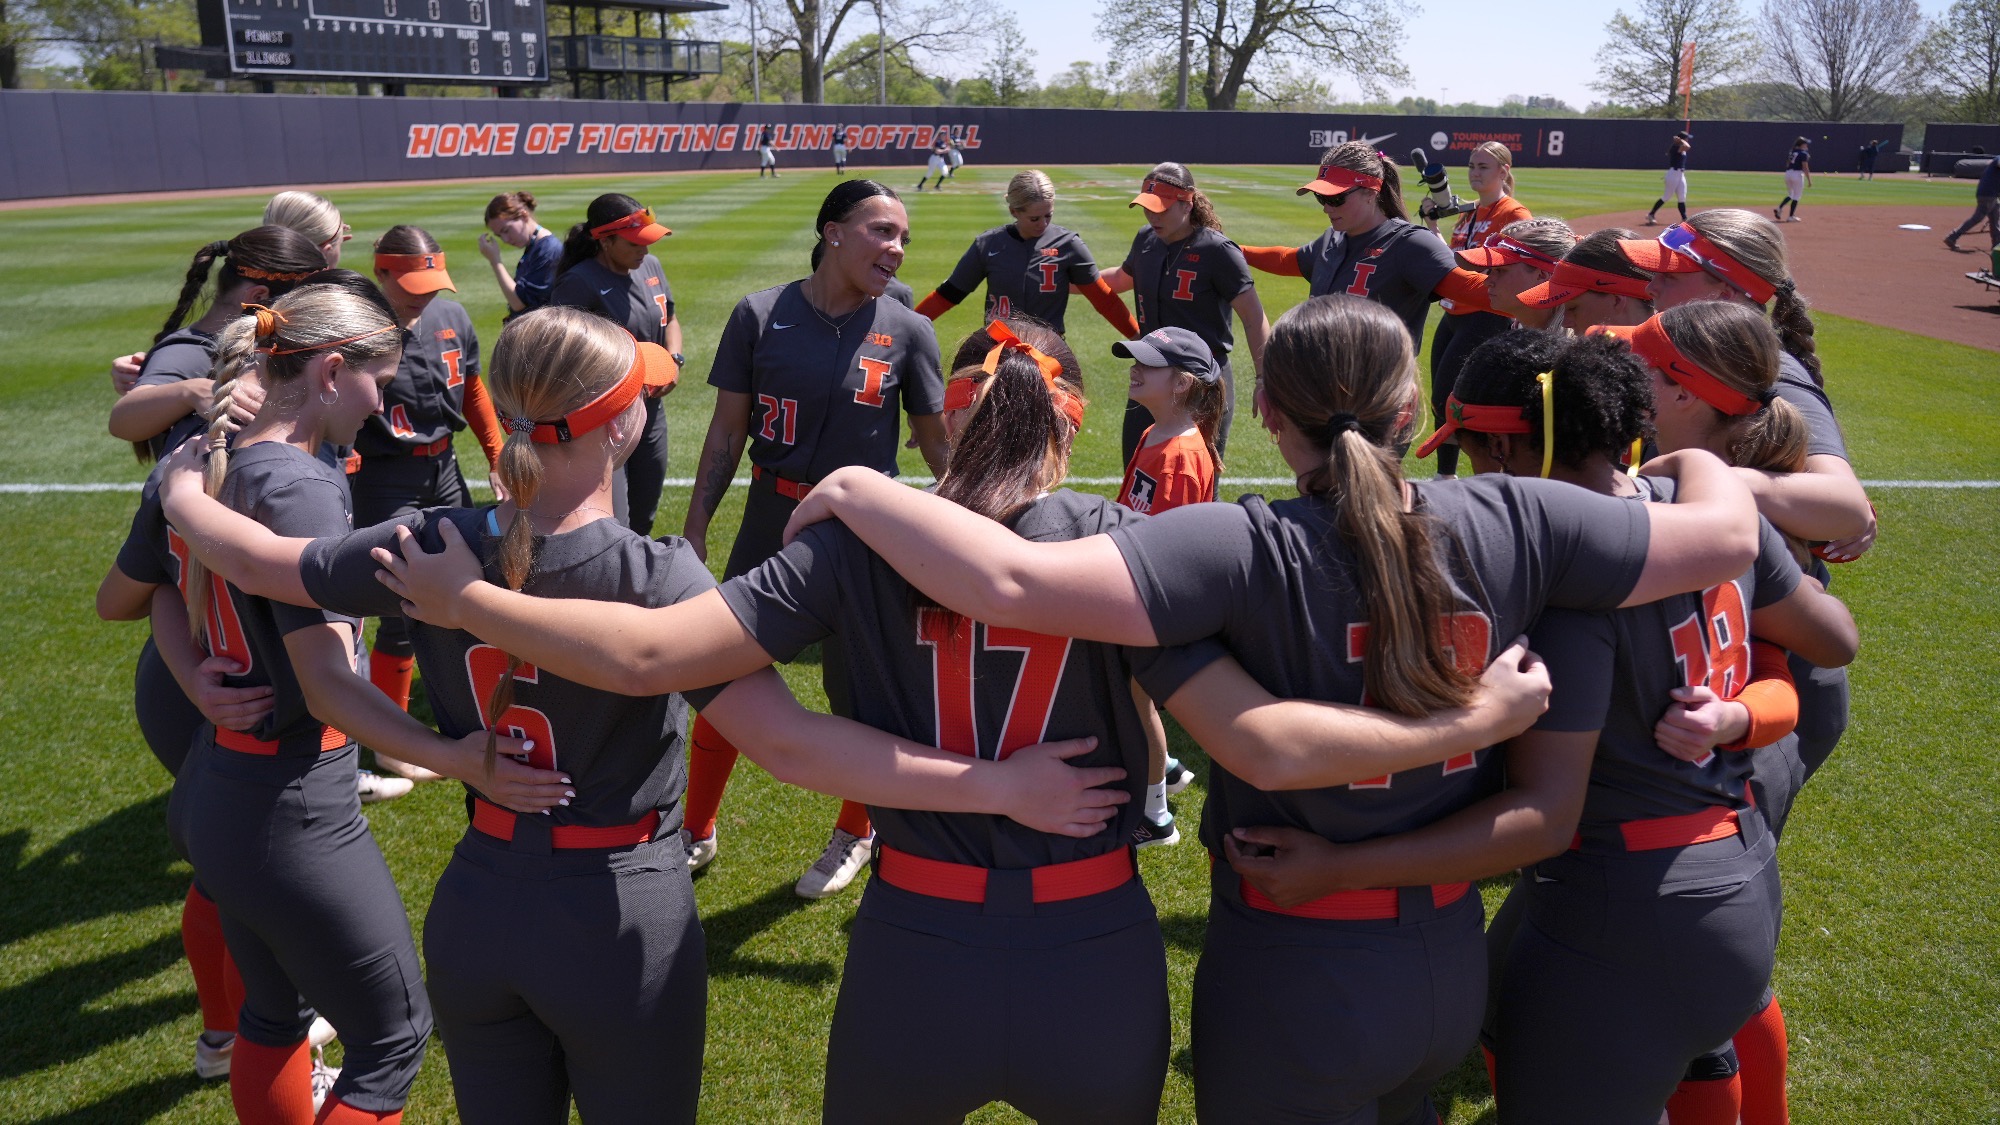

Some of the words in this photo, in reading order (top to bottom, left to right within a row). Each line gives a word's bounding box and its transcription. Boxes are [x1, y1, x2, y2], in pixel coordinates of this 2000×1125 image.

[469, 2, 481, 23] 0
[303, 18, 310, 30] 1
[317, 19, 325, 31] 2
[333, 20, 340, 32] 3
[349, 22, 357, 33] 4
[363, 22, 371, 34] 5
[393, 24, 400, 36] 7
[419, 26, 427, 37] 9
[432, 27, 444, 38] 10
[457, 28, 479, 40] RUNS
[492, 31, 510, 42] HITS
[521, 32, 537, 43] ERR
[469, 40, 478, 56] 0
[502, 41, 511, 57] 0
[525, 42, 535, 58] 0
[470, 58, 480, 74] 0
[503, 60, 512, 76] 0
[526, 60, 536, 76] 0
[406, 123, 520, 158] HOME
[524, 123, 574, 155] OF
[576, 123, 739, 154] FIGHTING
[1452, 132, 1522, 143] TOURNAMENT
[1547, 131, 1564, 155] 8
[425, 255, 435, 269] I
[1039, 263, 1058, 292] I
[1172, 269, 1197, 301] I
[1346, 262, 1377, 298] I
[1538, 290, 1571, 305] SOFTBALL
[441, 348, 464, 389] I
[853, 355, 893, 408] I
[758, 393, 798, 445] 21
[916, 606, 1074, 762] 17
[465, 643, 557, 772] 6
